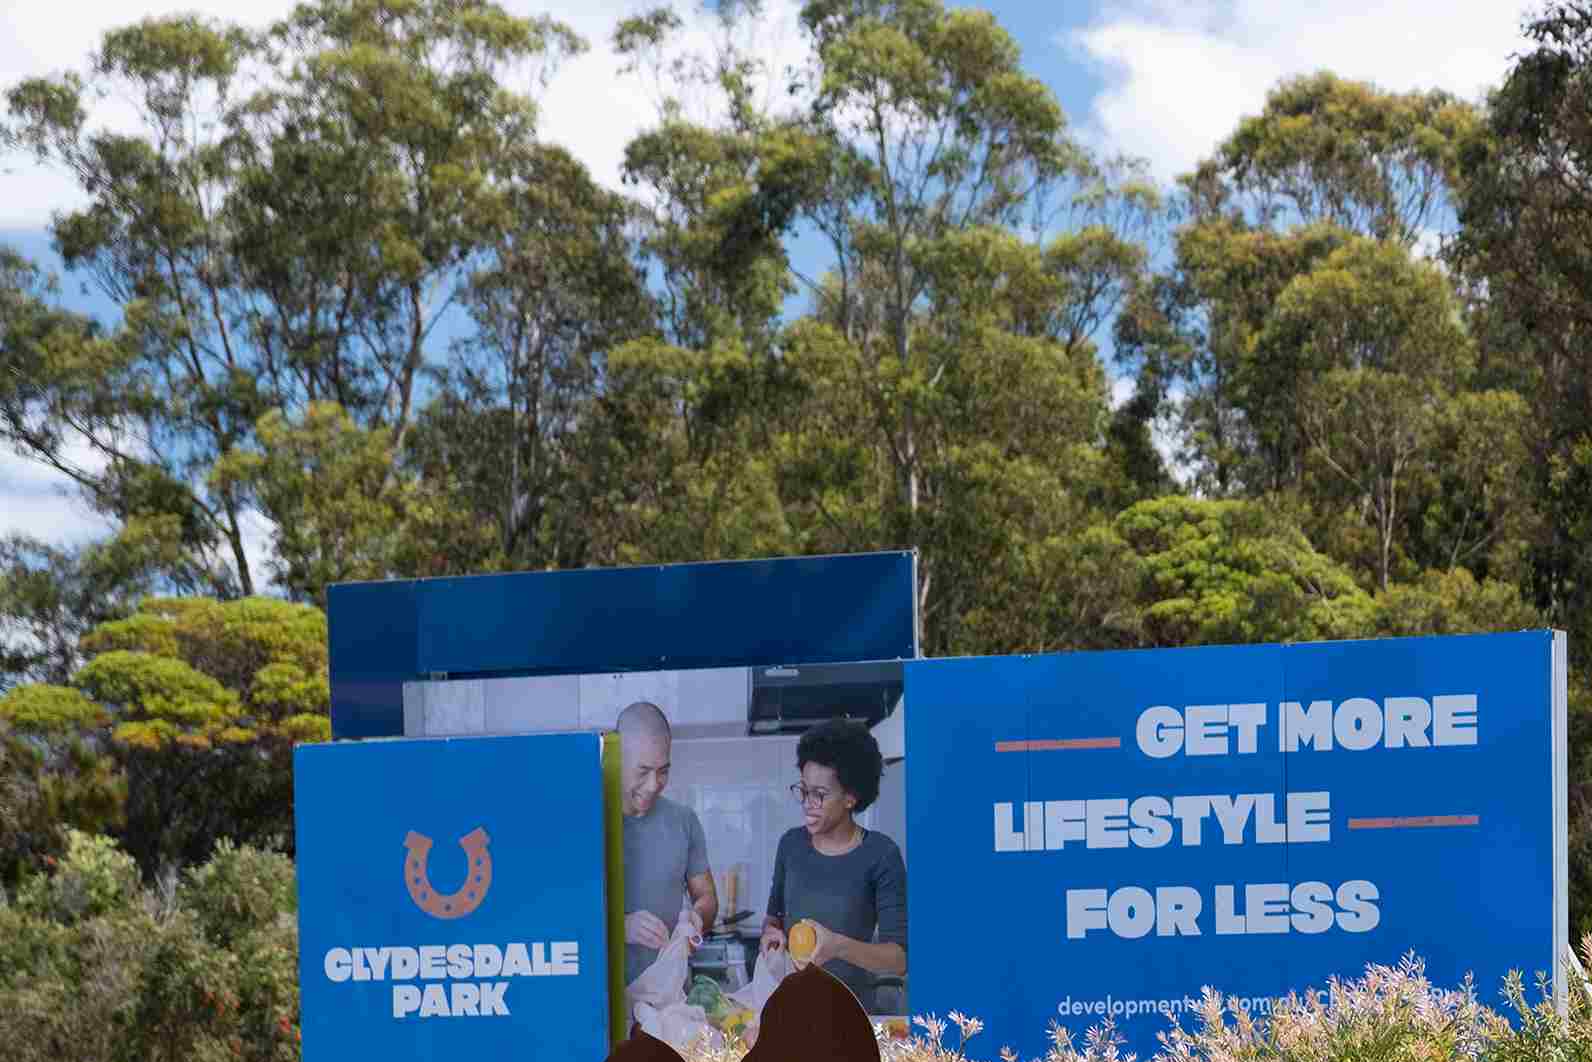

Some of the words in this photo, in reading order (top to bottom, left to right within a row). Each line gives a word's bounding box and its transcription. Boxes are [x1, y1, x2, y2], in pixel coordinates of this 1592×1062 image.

[1136, 703, 1266, 759] GET
[1279, 694, 1478, 752] MORE
[993, 792, 1331, 852] LIFESTYLE
[1066, 887, 1202, 939] FOR
[1215, 880, 1380, 935] LESS
[324, 941, 579, 982] CLYDESDALE
[392, 982, 510, 1018] PARK
